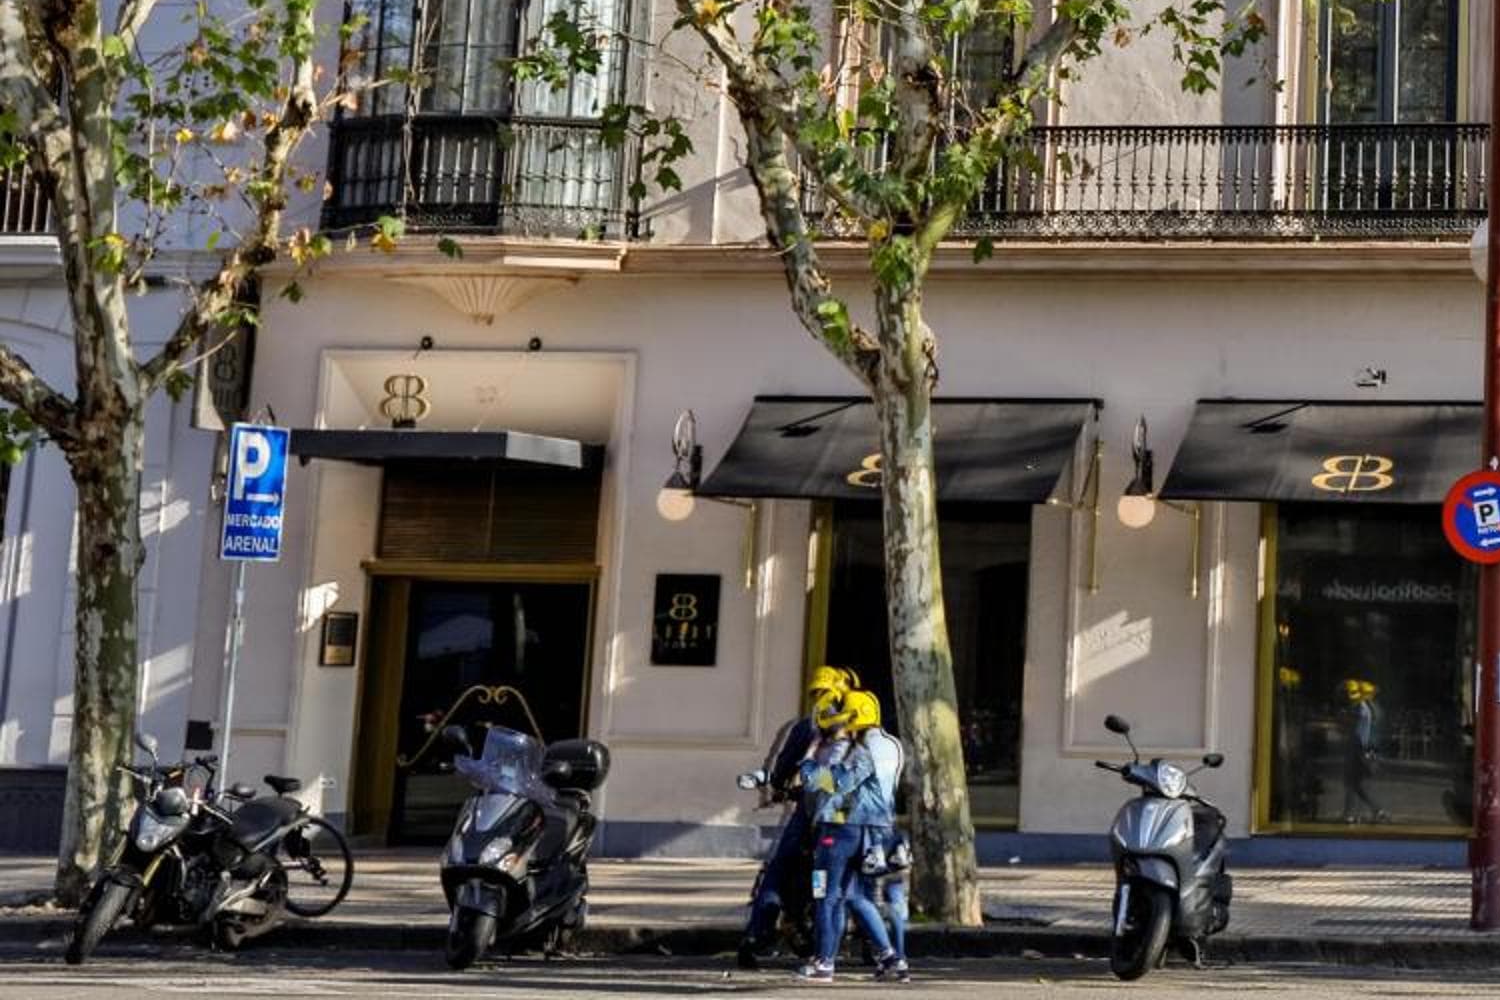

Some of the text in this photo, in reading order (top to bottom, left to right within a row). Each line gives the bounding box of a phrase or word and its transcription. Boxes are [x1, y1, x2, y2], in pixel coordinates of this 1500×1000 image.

[233, 431, 271, 500] P
[226, 513, 281, 530] MERCADO
[1479, 503, 1494, 523] P
[224, 535, 279, 553] ARENAL
